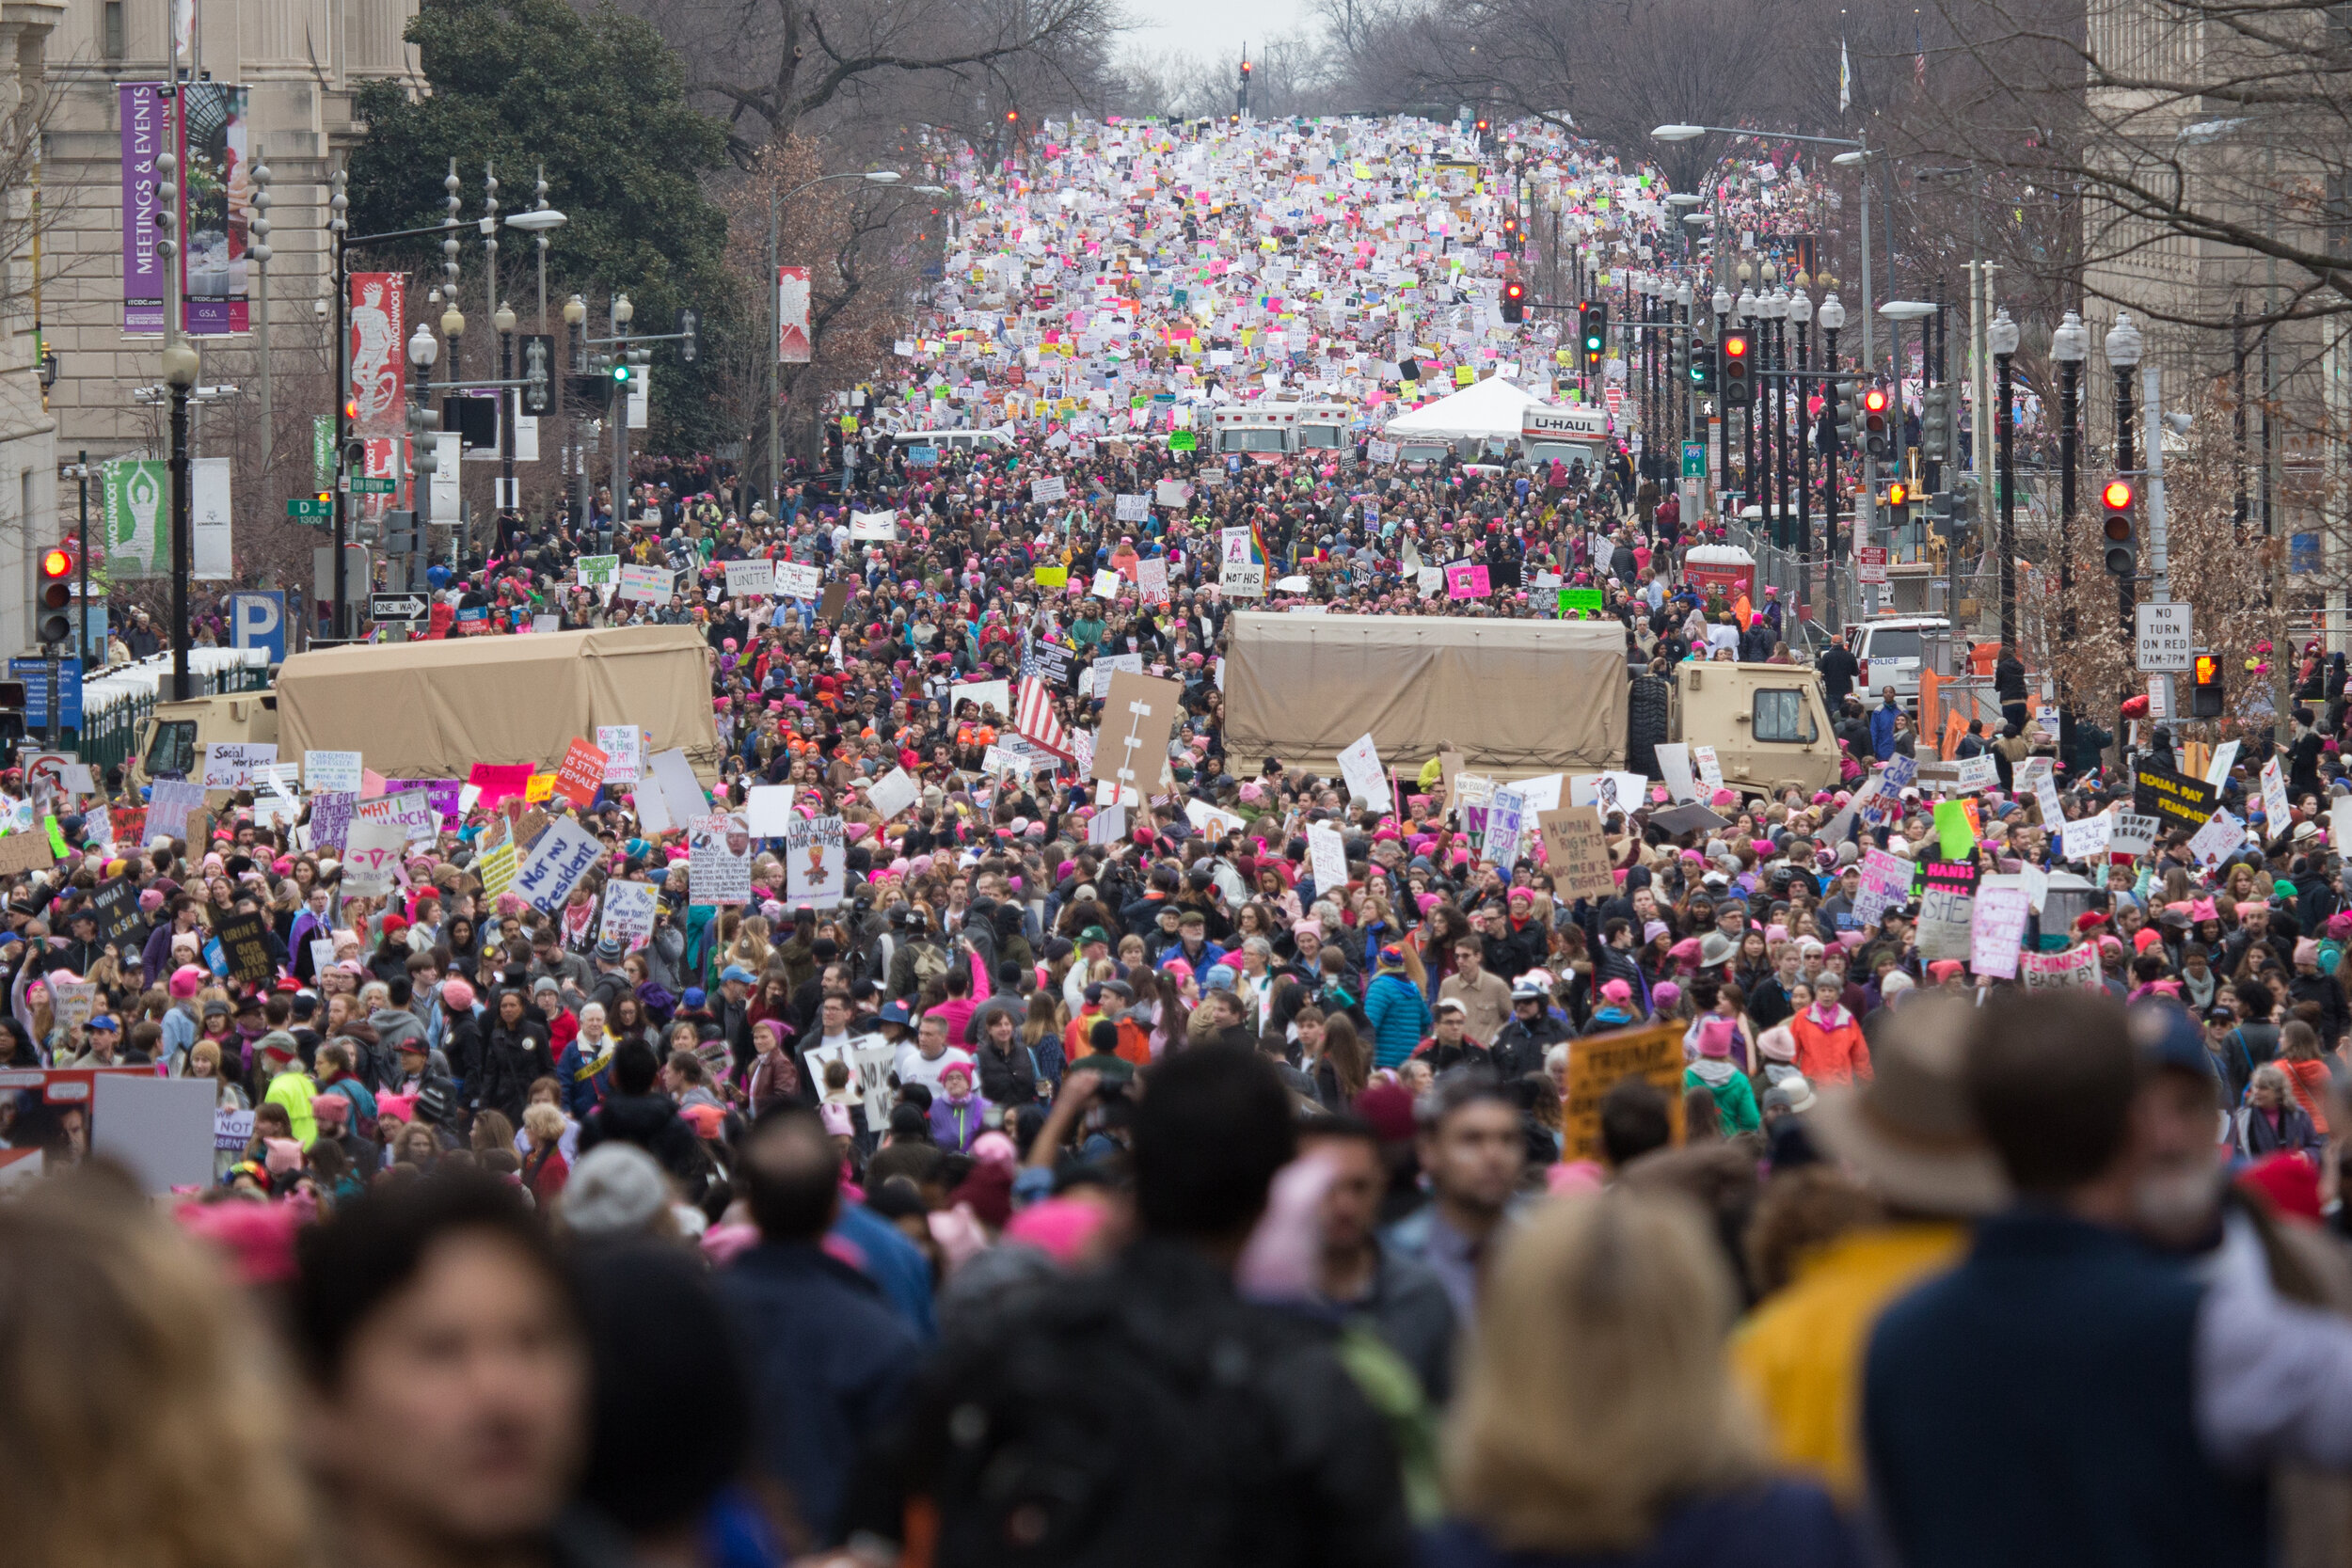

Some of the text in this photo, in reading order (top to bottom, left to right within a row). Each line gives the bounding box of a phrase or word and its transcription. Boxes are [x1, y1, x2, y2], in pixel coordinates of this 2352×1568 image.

[134, 87, 153, 275] MEETINGS & EVENTS
[199, 309, 217, 318] GSA
[390, 291, 401, 352] DOWNTOWN
[1535, 418, 1596, 432] U-HAUL
[911, 447, 937, 456] SILENCE
[1343, 448, 1355, 460] NO!
[352, 480, 385, 492] RON BROWN
[299, 501, 310, 514] D
[1117, 496, 1148, 508] MY BODY
[106, 483, 119, 552] DOWNTOWN
[299, 515, 322, 524] 1300
[1117, 509, 1127, 518] MY
[734, 572, 769, 587] UNITE
[791, 573, 803, 581] ME
[1226, 572, 1260, 584] NOT HIS
[1687, 572, 1700, 583] I'M
[1141, 588, 1168, 605] WALLS
[375, 603, 418, 612] ONE WAY
[2155, 608, 2172, 618] NO
[236, 595, 279, 648] P
[2149, 624, 2181, 634] TURN
[2142, 639, 2186, 650] ON RED
[1094, 658, 1115, 669] SWAMP
[1868, 657, 1899, 666] POLICE
[2142, 654, 2185, 664] 7AM-7PM
[215, 745, 244, 759] Social
[570, 746, 583, 757] THE
[617, 752, 628, 763] MY
[232, 756, 271, 768] Workers
[564, 755, 601, 780] IS STILL
[205, 773, 233, 786] Social
[559, 766, 598, 792] FEMALE
[1963, 773, 1985, 782] LIBERAL
[2138, 772, 2204, 803] EQUAL PAY
[312, 791, 357, 807] I'VE GOT
[358, 799, 403, 819] WHY I
[2158, 797, 2211, 824] FEMINIST
[310, 817, 330, 829] RAGE
[788, 818, 842, 837] LIAR, LIAR
[2122, 816, 2153, 829] DUMP
[2272, 812, 2287, 829] ALL
[310, 828, 328, 841] OUT
[1548, 819, 1591, 838] HUMAN
[2113, 827, 2153, 844] TRUMP
[788, 833, 841, 851] HAIR ON FIRE
[1559, 833, 1602, 850] RIGHTS
[1569, 848, 1587, 862] ARE
[1866, 849, 1898, 873] GIRLS
[519, 837, 568, 891] Not my
[1552, 860, 1608, 879] WOMEN'S
[1928, 863, 1975, 879] HANDS
[532, 842, 598, 914] President
[1569, 872, 1611, 891] RIGHTS
[94, 883, 125, 909] WHAT
[1859, 873, 1908, 904] FUNDING
[112, 906, 121, 919] A
[1923, 890, 1970, 924] SHE
[107, 911, 140, 940] LOSER
[222, 923, 260, 942] URINE
[235, 941, 262, 956] OVER
[239, 951, 269, 967] YOUR
[2020, 946, 2092, 973] FEMINISM
[234, 964, 268, 983] HEAD
[2028, 970, 2070, 988] BACK
[2076, 964, 2094, 982] BY
[859, 1061, 877, 1090] NO
[220, 1121, 251, 1134] NOT
